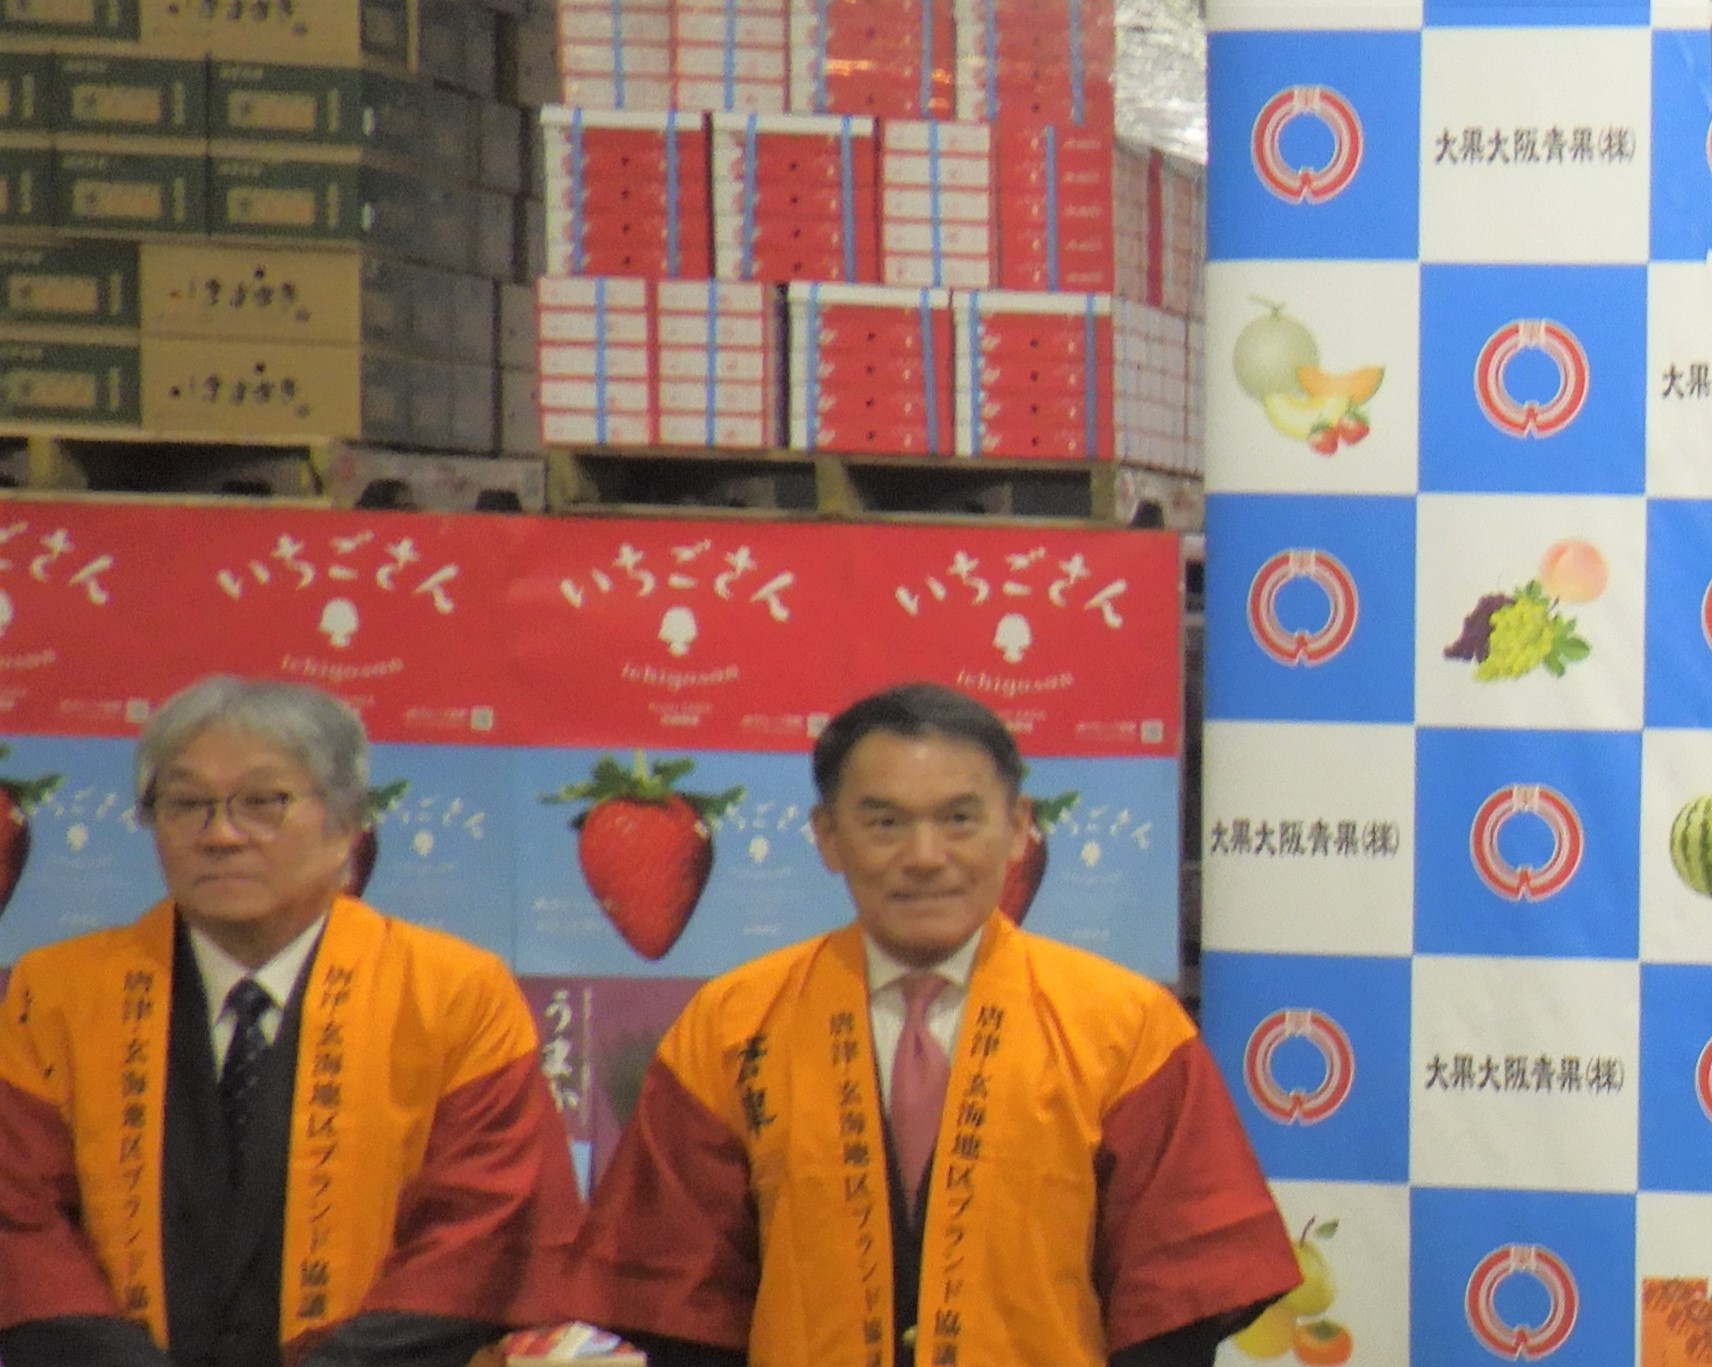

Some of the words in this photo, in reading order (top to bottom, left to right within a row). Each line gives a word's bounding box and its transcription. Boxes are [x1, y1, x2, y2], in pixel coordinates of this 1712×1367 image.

[216, 530, 460, 615] いちごさん
[560, 538, 796, 623] いちごさん
[895, 546, 1128, 630] いちごさん
